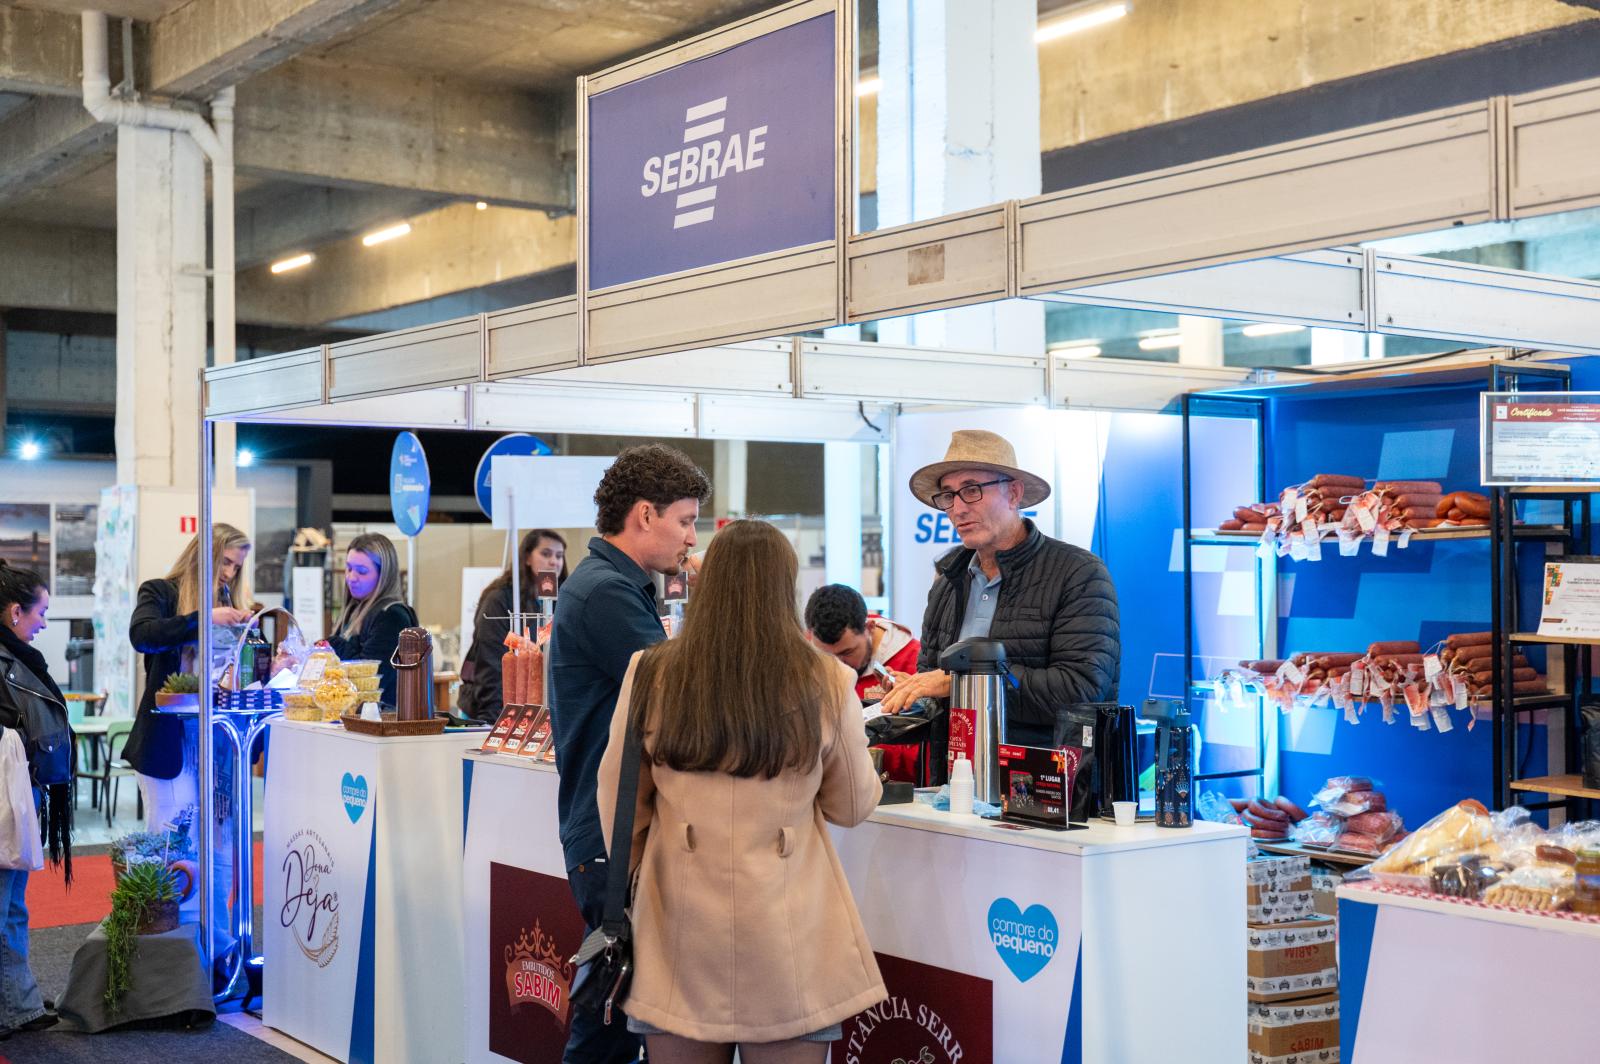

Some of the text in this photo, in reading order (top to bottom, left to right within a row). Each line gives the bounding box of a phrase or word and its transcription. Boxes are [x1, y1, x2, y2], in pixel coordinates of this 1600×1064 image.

[641, 125, 768, 198] SEBRAE
[303, 844, 332, 883] Dona
[992, 918, 1054, 942] compre do
[993, 931, 1054, 958] pequeno
[521, 960, 556, 981] EMBUTIDOS
[515, 971, 561, 1011] SABIM
[845, 996, 964, 1064] STÂNCIA SERR
